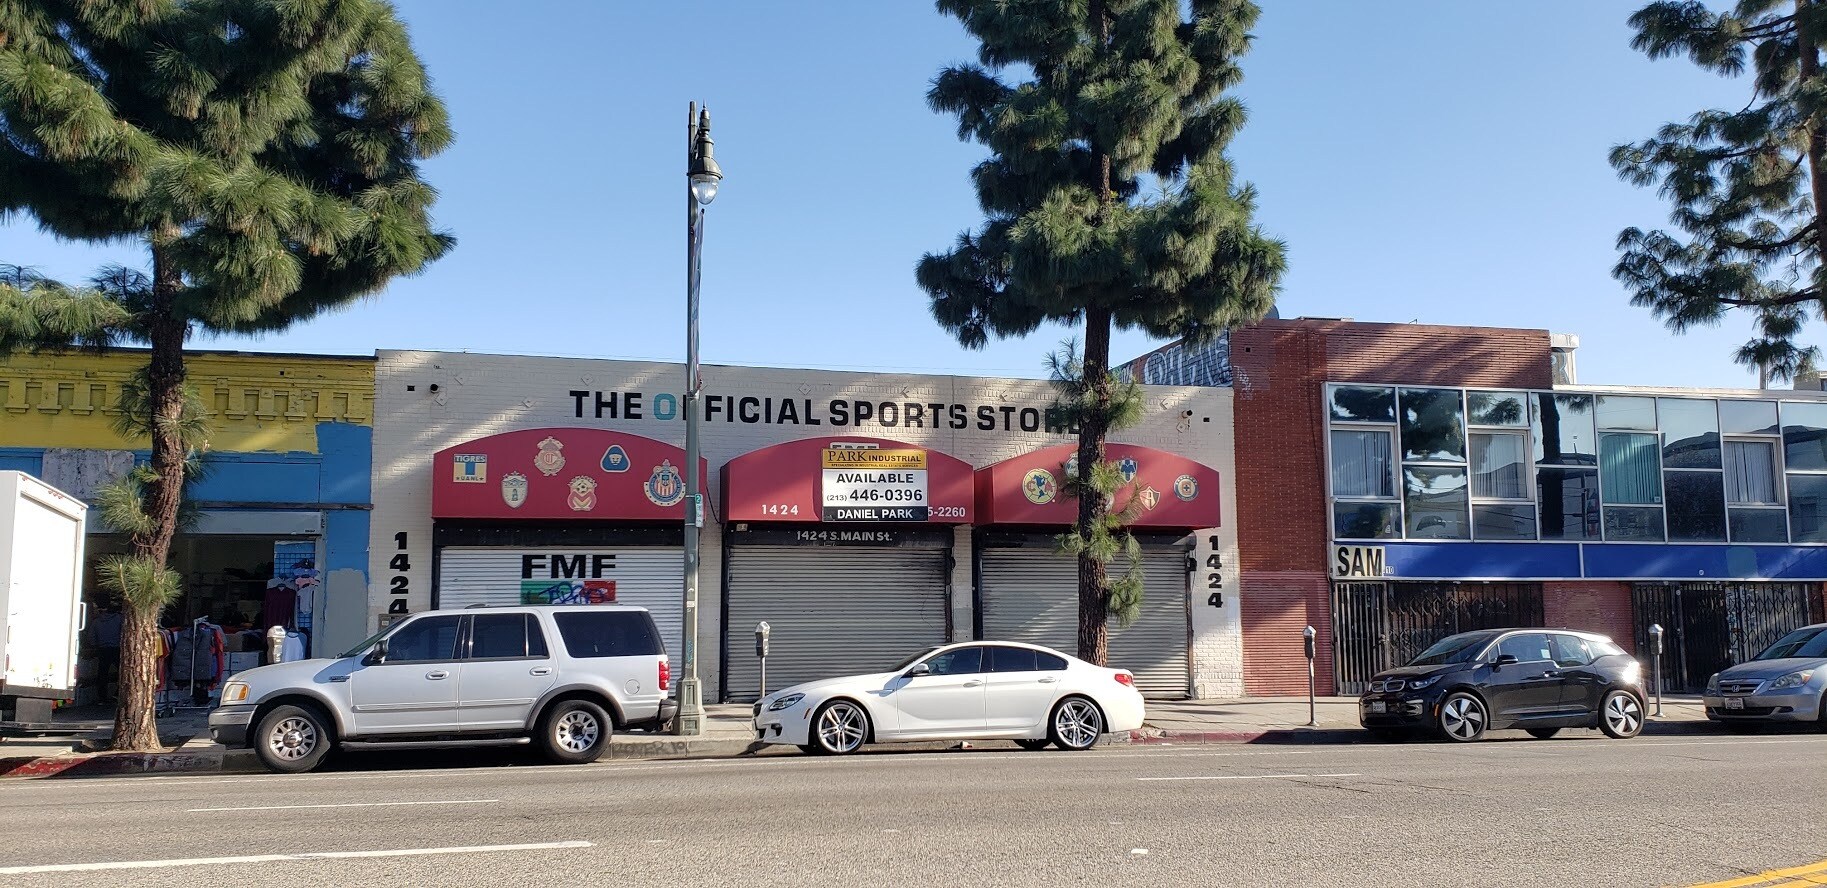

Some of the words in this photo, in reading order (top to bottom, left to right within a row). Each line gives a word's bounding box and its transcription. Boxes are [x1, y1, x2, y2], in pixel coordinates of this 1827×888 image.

[569, 390, 643, 420] THE
[653, 393, 821, 426] OFICIAL
[829, 400, 968, 430] SPORTS
[455, 455, 486, 463] TIGRES
[828, 450, 867, 462] PARK
[868, 454, 922, 462] INDUSTRIAL
[836, 473, 914, 483] AVAILABLE
[826, 494, 848, 502] (213)
[849, 489, 923, 501] 446-0396
[761, 504, 799, 516] 1424
[837, 509, 879, 519] DANIEL
[881, 509, 914, 519] PARK
[796, 530, 828, 541] 1424
[521, 554, 617, 579] FMF
[1337, 546, 1383, 577] SAM
[389, 531, 411, 615] 1424
[1206, 535, 1224, 609] 1424
